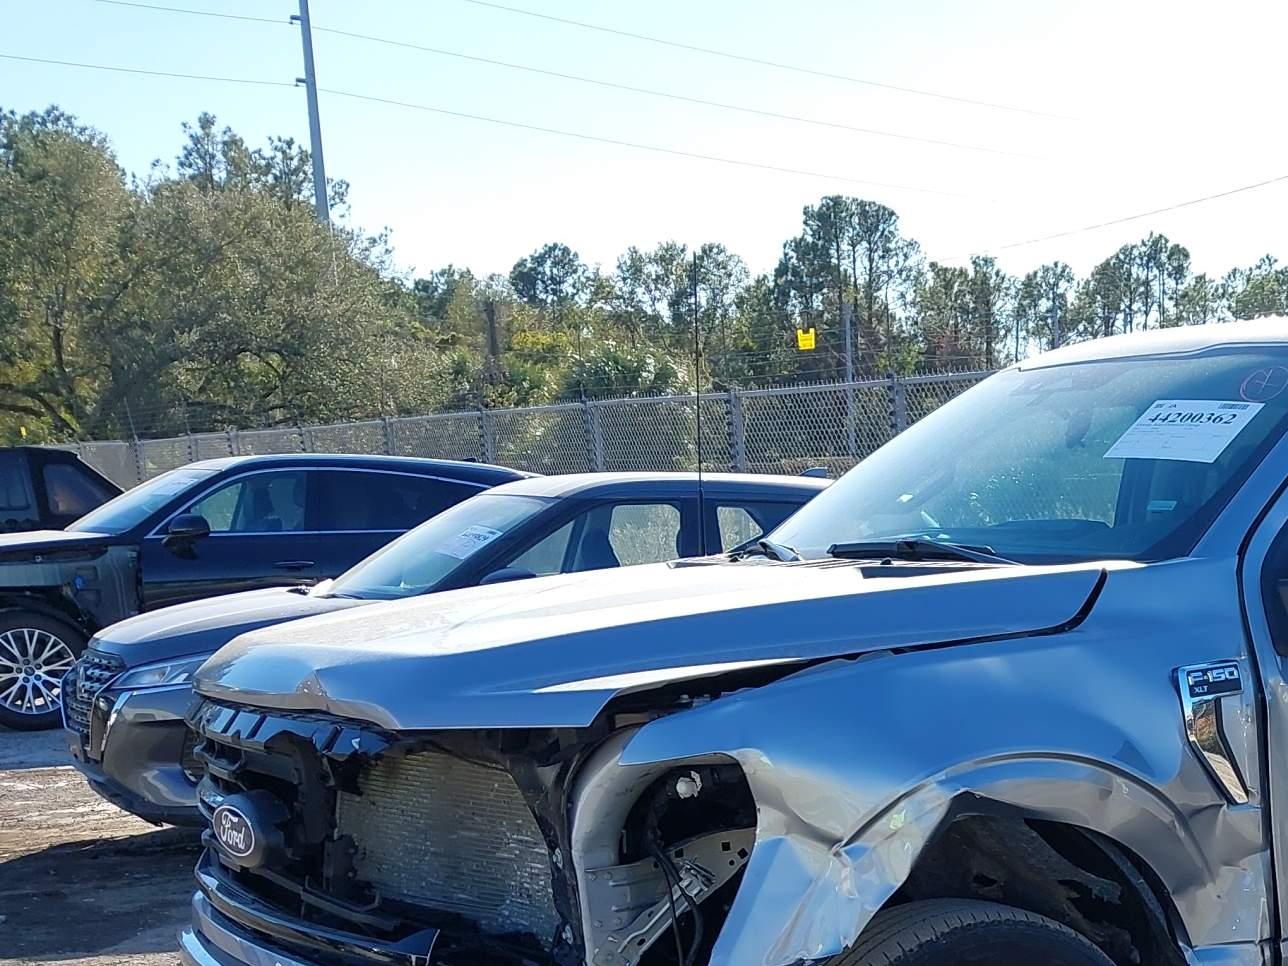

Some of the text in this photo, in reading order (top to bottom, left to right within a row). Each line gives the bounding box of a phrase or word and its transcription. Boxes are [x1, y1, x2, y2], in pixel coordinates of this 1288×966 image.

[1149, 412, 1239, 426] 44200362
[1188, 667, 1239, 686] F-150
[1193, 685, 1208, 694] XLT
[220, 811, 246, 850] Ford
